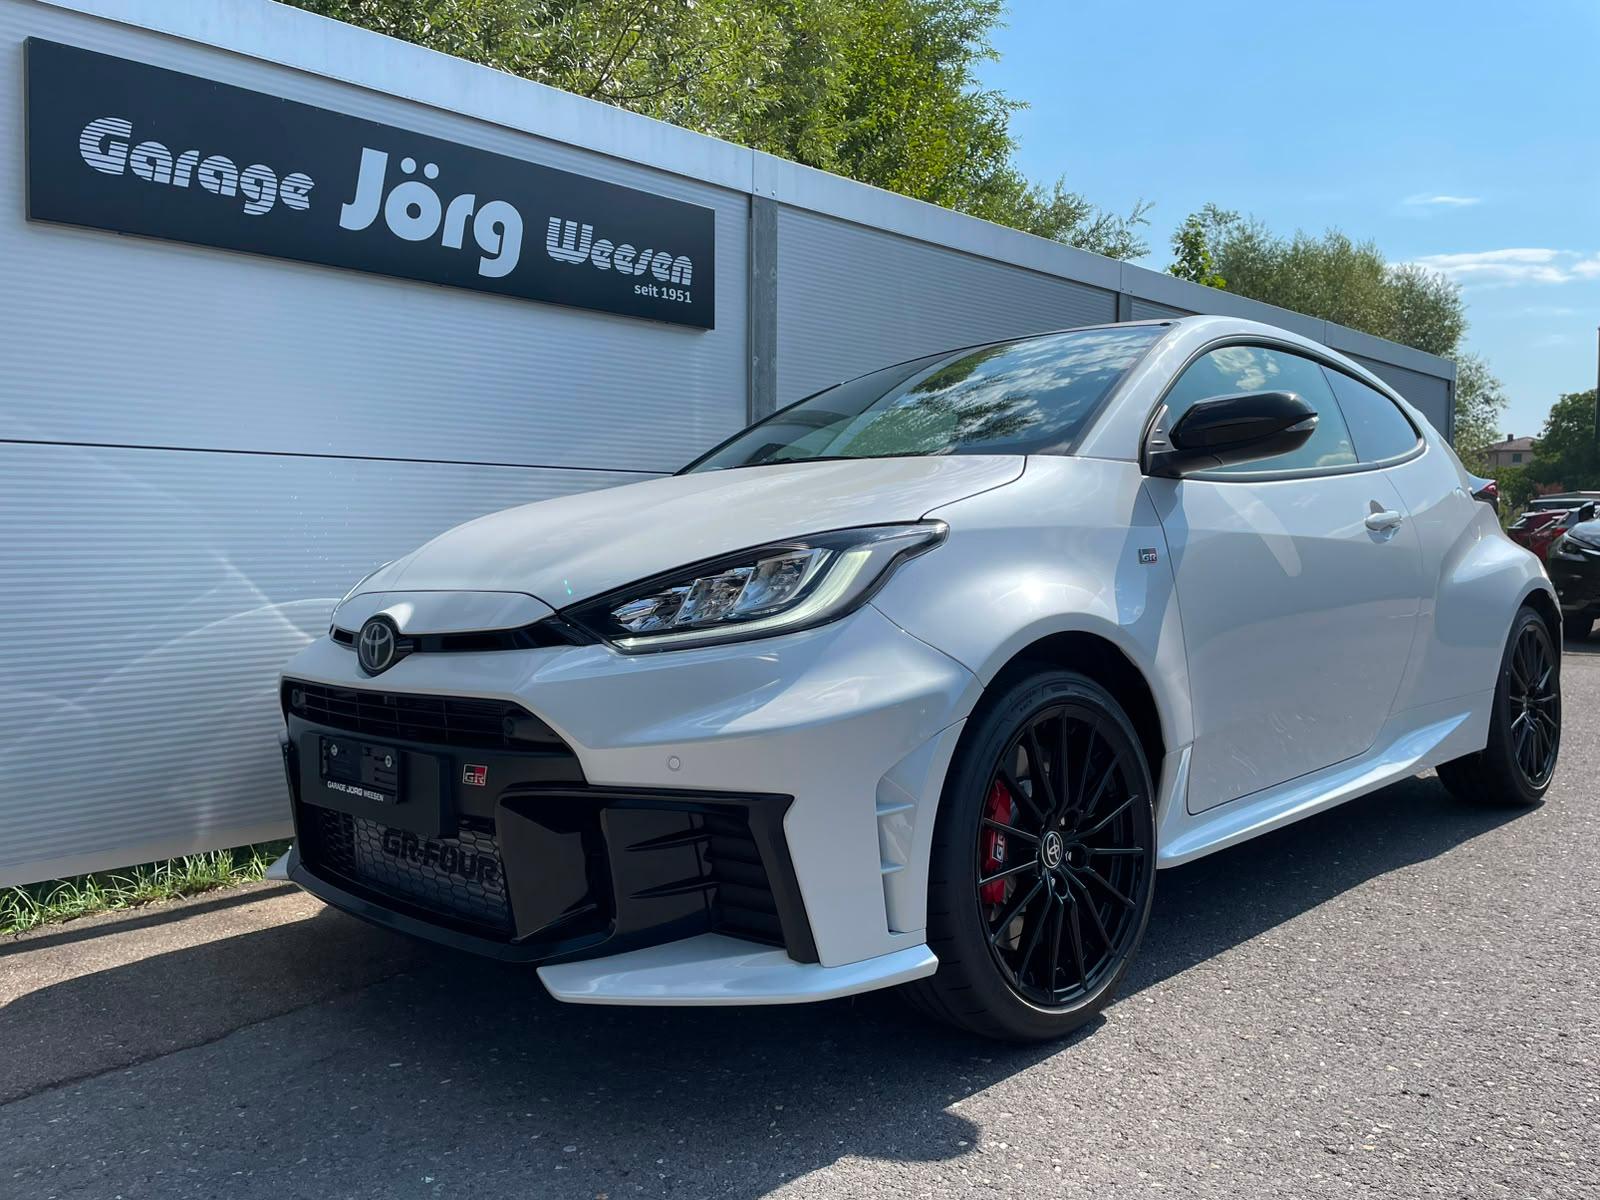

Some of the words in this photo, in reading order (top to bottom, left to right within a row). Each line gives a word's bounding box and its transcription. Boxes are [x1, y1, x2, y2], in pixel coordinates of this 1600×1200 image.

[79, 117, 315, 215] Garage
[339, 147, 524, 278] Jörg
[546, 216, 693, 286] Weesen
[634, 284, 659, 298] seit
[661, 287, 692, 303] 1951
[464, 770, 485, 784] GR
[384, 830, 498, 882] GR-FOUR
